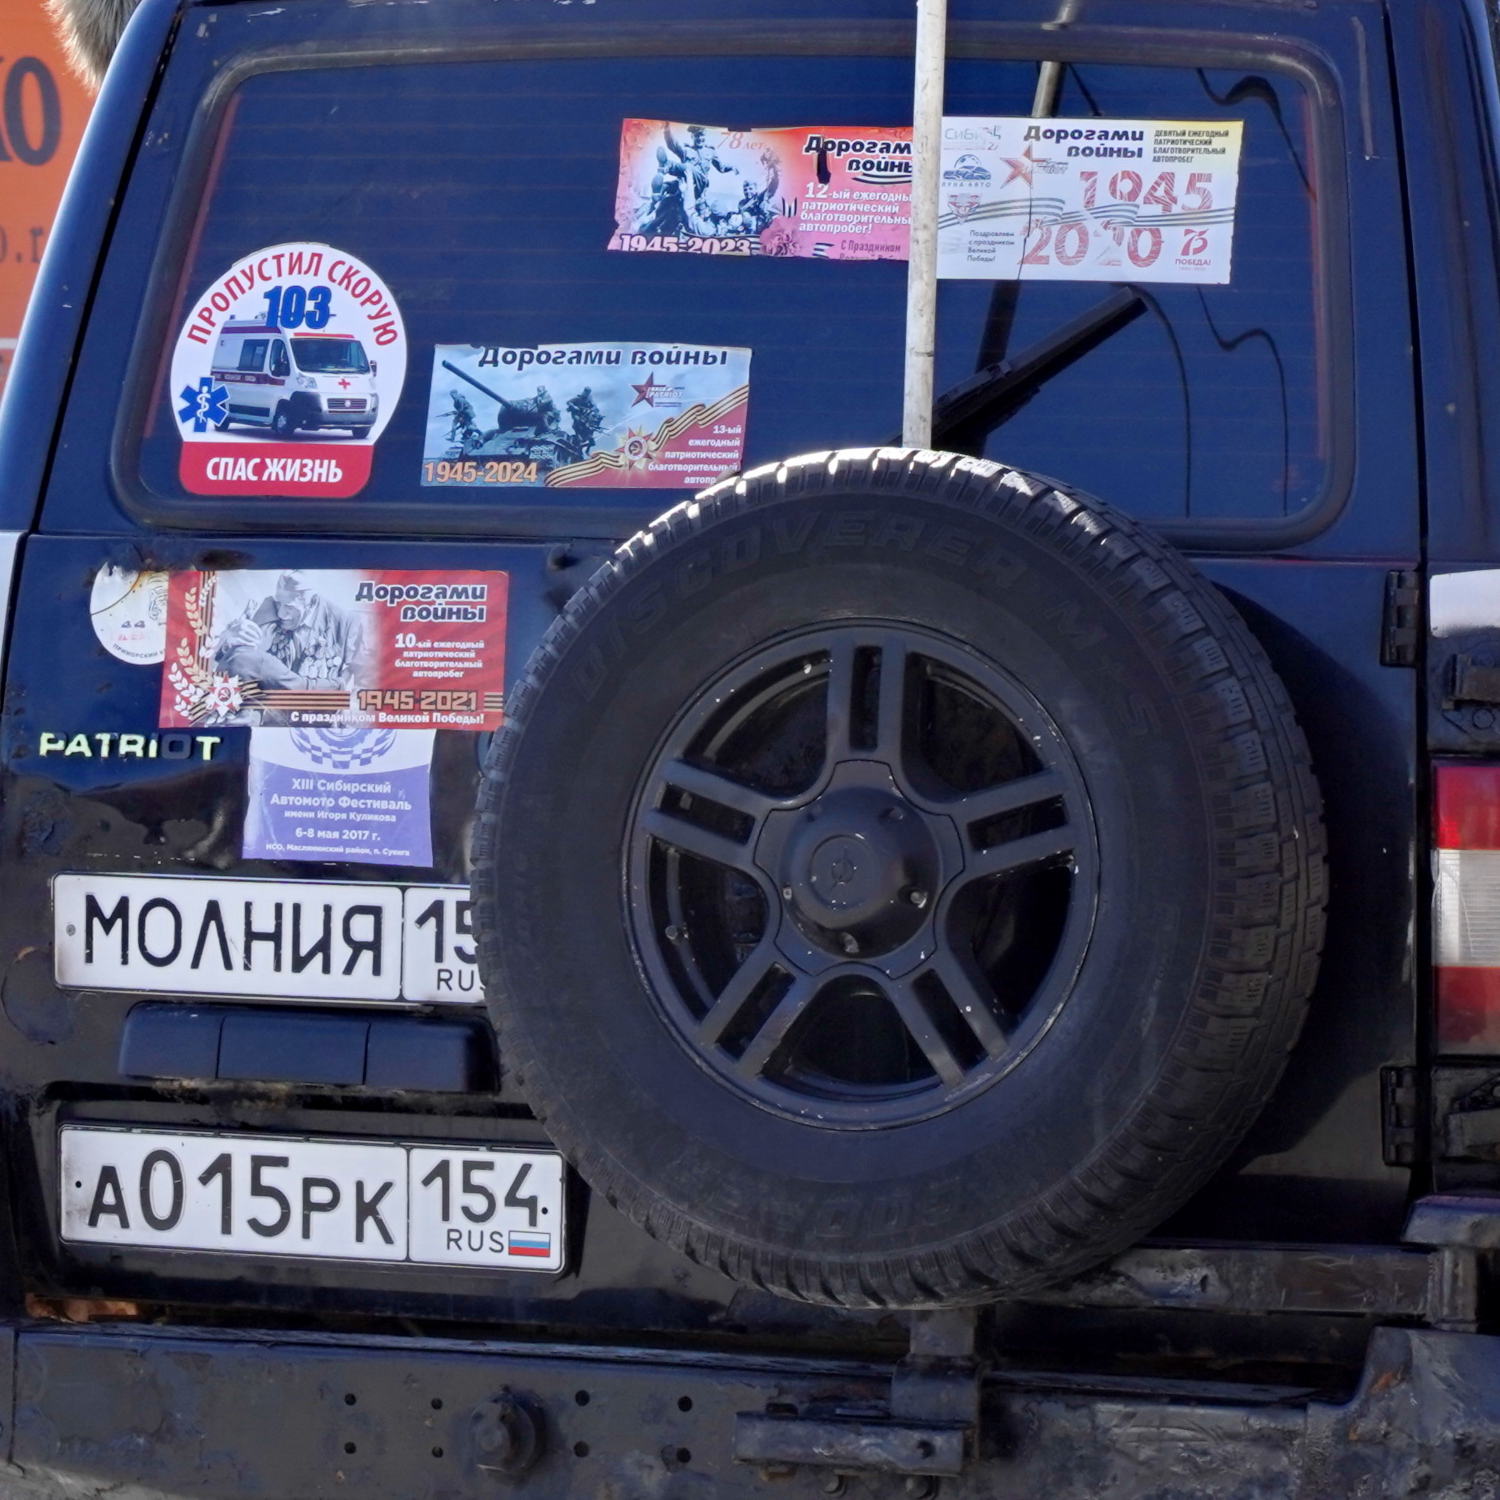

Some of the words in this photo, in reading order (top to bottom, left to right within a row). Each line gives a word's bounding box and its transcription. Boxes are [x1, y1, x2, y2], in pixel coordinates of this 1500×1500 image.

[717, 131, 745, 149] 78
[1023, 125, 1145, 144] Дорогами
[1154, 137, 1213, 146] ПАТРИОТИЧЕСКИЙ
[803, 135, 912, 157] Дорогам
[1066, 143, 1143, 158] войны
[1152, 155, 1194, 164] АВТОПРОБЕГ
[1078, 170, 1213, 213] 1945
[802, 201, 899, 214] патриотический
[800, 211, 911, 225] благотворительны
[799, 222, 872, 234] автопробег!
[1180, 227, 1209, 257] 75
[1175, 258, 1212, 266] ПОБЕДА!
[187, 251, 324, 345] ПРОПУСТИЛ
[327, 260, 398, 346] СКОРУЮ
[263, 285, 332, 330] 103
[478, 348, 622, 371] Дорогами
[630, 346, 728, 366] войны
[712, 424, 742, 435] 13-ый
[688, 437, 741, 448] ежегодный
[664, 450, 739, 461] патриотический
[206, 457, 260, 481] СПАС
[261, 458, 343, 484] ЖИЗНЬ
[423, 461, 538, 483] 1945-2024
[683, 475, 717, 486] автопр
[355, 581, 487, 605] Дорогами
[401, 602, 486, 622] войны
[432, 639, 485, 649] ежегодный
[403, 650, 476, 660] патриотический
[394, 659, 483, 669] благотворительный
[412, 669, 465, 679] автопробег
[291, 712, 300, 723] С
[301, 713, 376, 726] праздником
[378, 712, 430, 724] Великой
[432, 712, 485, 725] Победы!
[39, 732, 221, 761] PATRIOT
[317, 779, 392, 794] Сибирский
[270, 793, 336, 808] Автомото
[338, 795, 412, 811] Фестиваль
[284, 810, 315, 819] имени
[317, 811, 347, 821] Игоря
[349, 811, 397, 822] Куликова
[295, 827, 315, 839] 6-8
[317, 830, 340, 839] мая
[342, 829, 370, 840] 2017
[84, 893, 384, 977] МОЛНИЯ
[414, 899, 477, 965] 15
[87, 1147, 395, 1246] А015РК
[420, 1158, 539, 1228] 154
[445, 1227, 505, 1254] RUS
